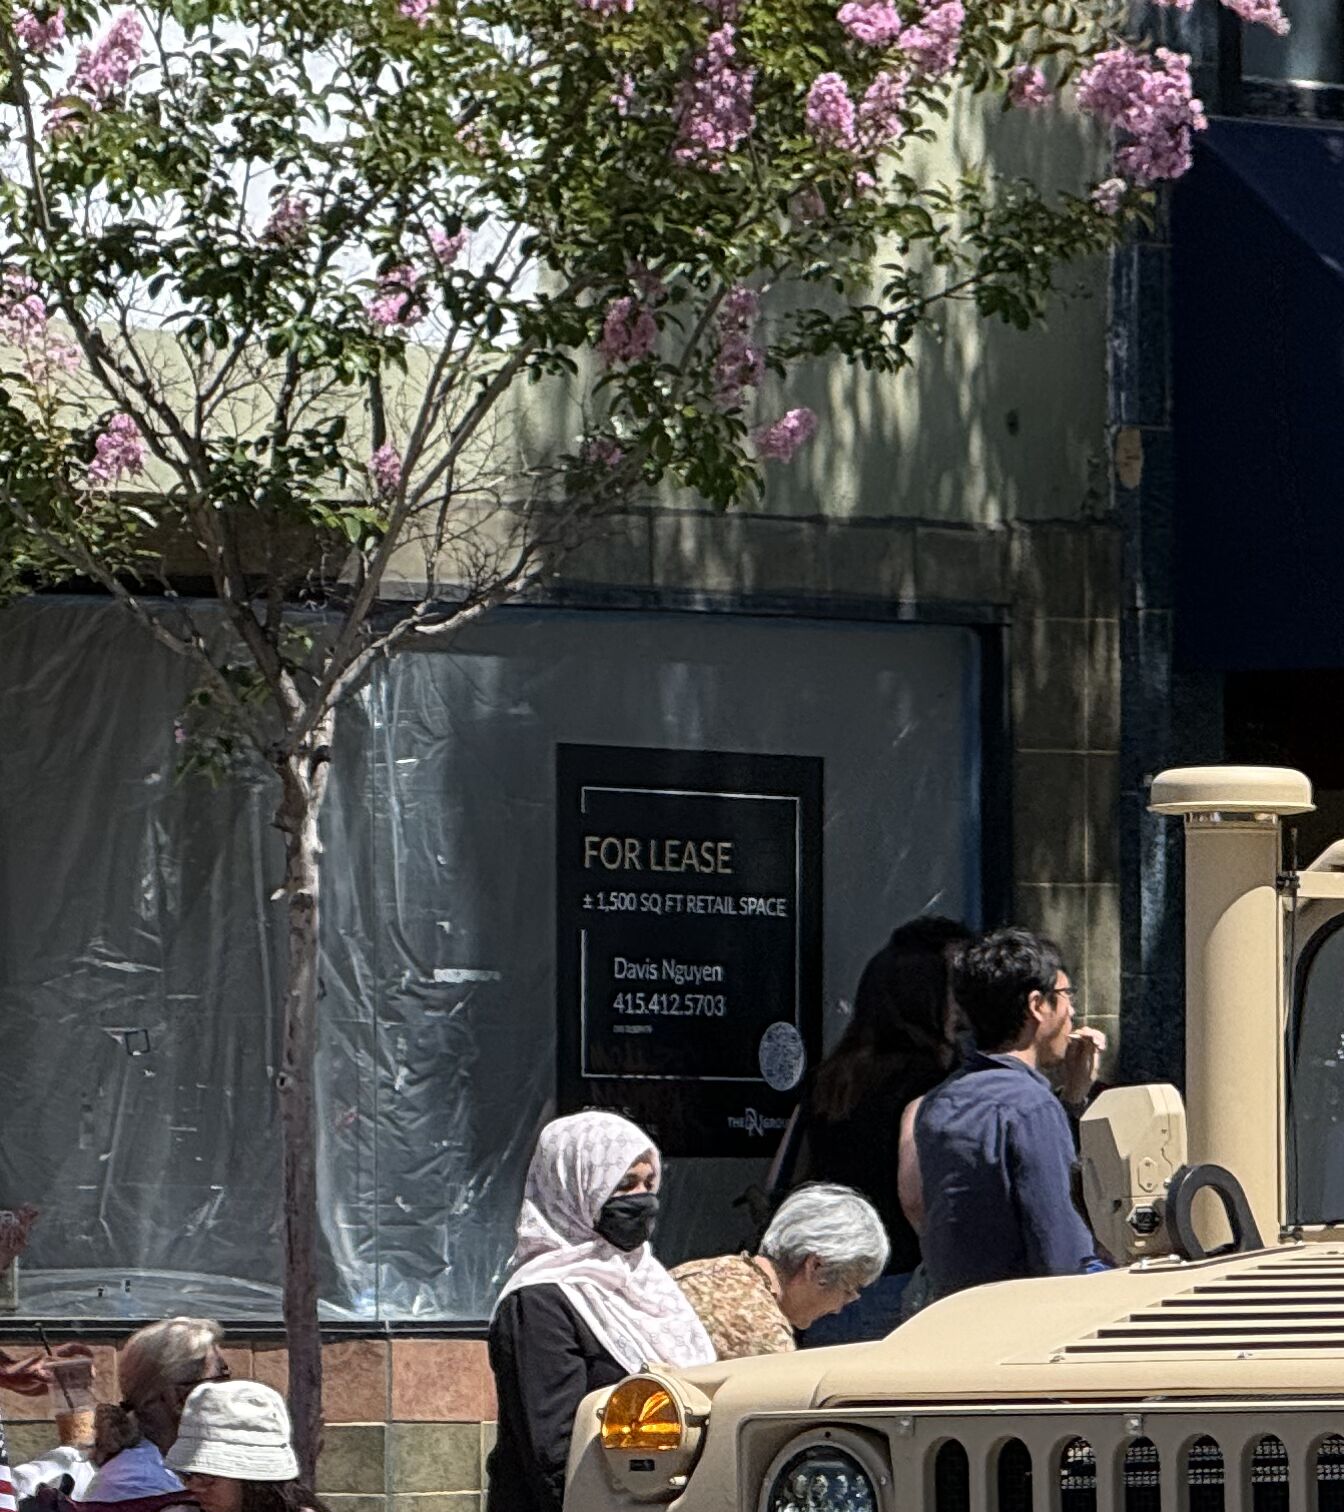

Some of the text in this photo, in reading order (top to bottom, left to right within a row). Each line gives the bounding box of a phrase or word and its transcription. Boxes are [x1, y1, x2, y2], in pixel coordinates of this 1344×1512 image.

[583, 835, 735, 875] FOR LEASE
[596, 891, 637, 913] 1,500
[641, 893, 662, 915] SQ
[665, 894, 685, 914] FT
[686, 894, 738, 916] RETAIL
[739, 896, 788, 918] SPACE
[613, 957, 723, 986] Davis Nguyen
[612, 992, 726, 1018] 415.412.5703
